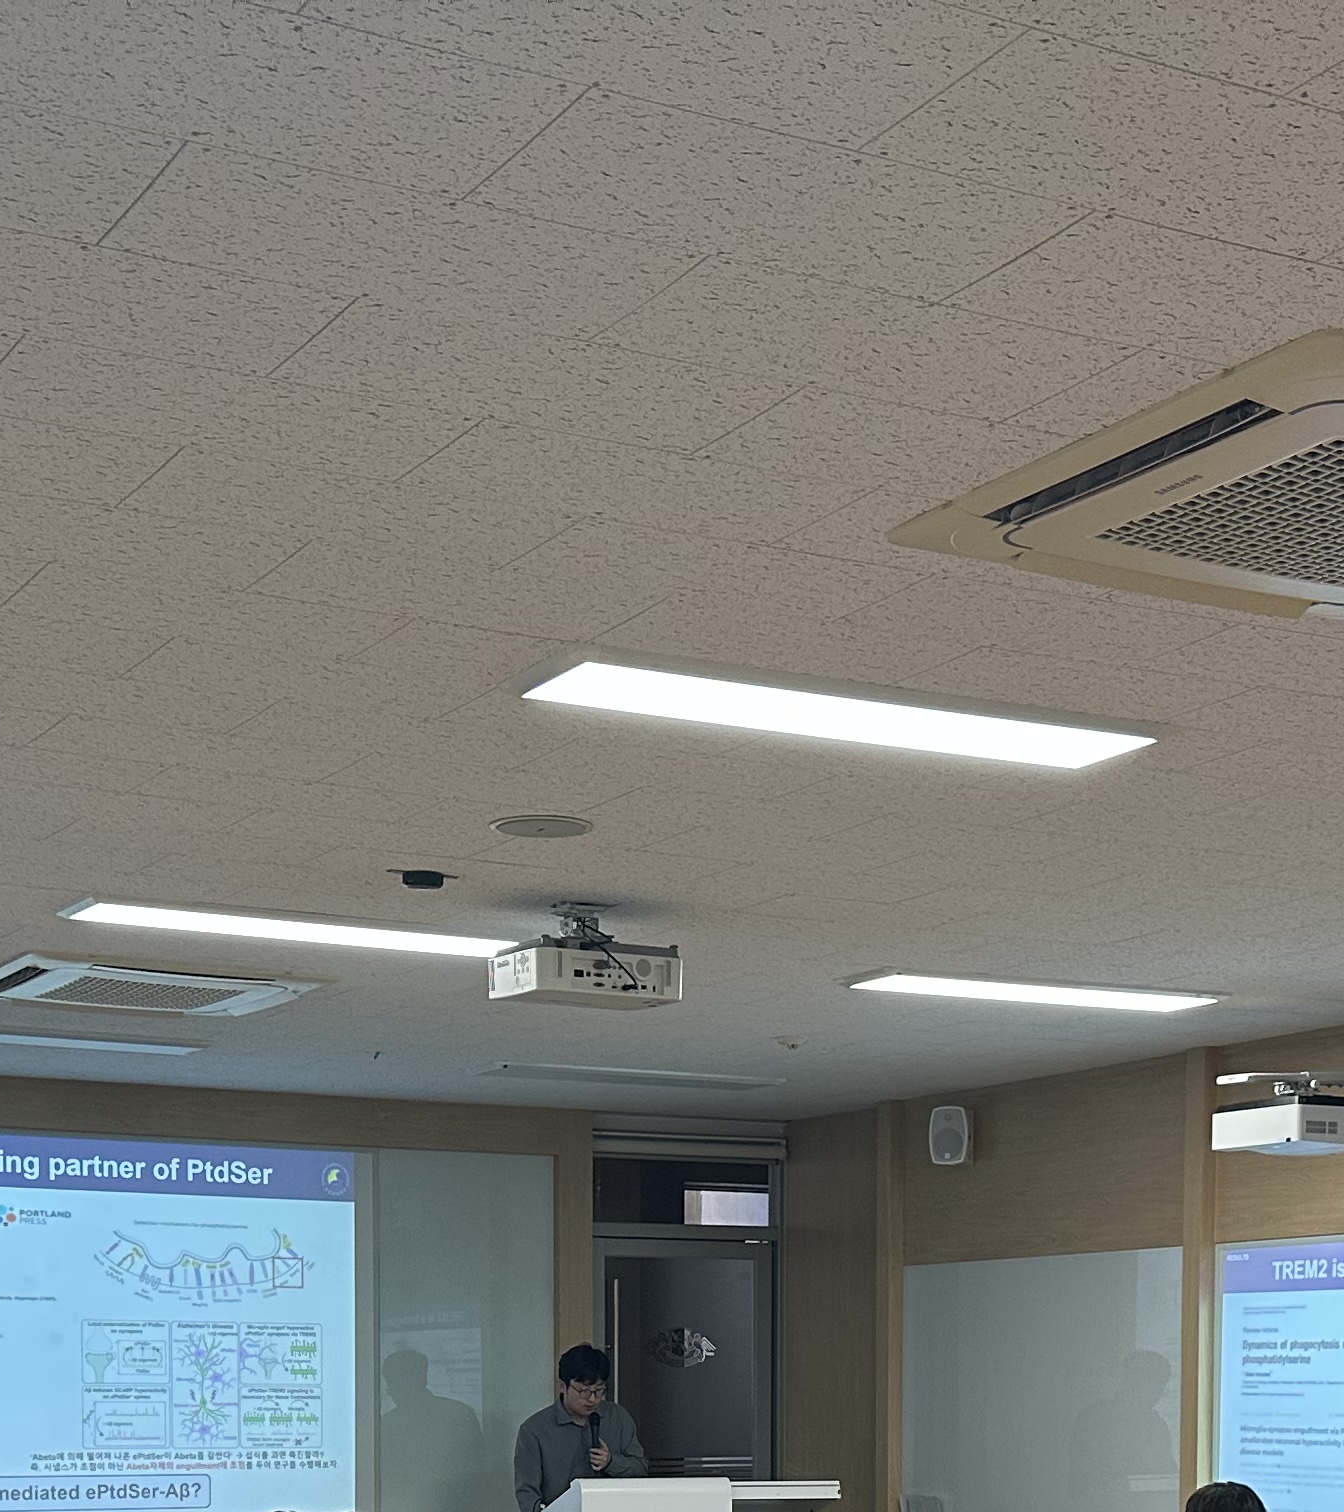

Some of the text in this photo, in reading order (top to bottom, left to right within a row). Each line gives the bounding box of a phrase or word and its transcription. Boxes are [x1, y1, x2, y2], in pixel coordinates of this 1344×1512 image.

[48, 1155, 146, 1181] partner
[152, 1157, 181, 1181] of
[187, 1158, 274, 1185] PtdSer
[18, 1208, 72, 1219] PORTLAND
[18, 1217, 48, 1225] PRESS
[1272, 1258, 1328, 1281] TREM2
[1242, 1339, 1278, 1351] Dynamics
[1280, 1339, 1289, 1350] of
[1289, 1339, 1340, 1351] phagocytosis
[1242, 1354, 1311, 1366] phosphatidylserine
[85, 1481, 202, 1502] ePtdSer-Aβ?
